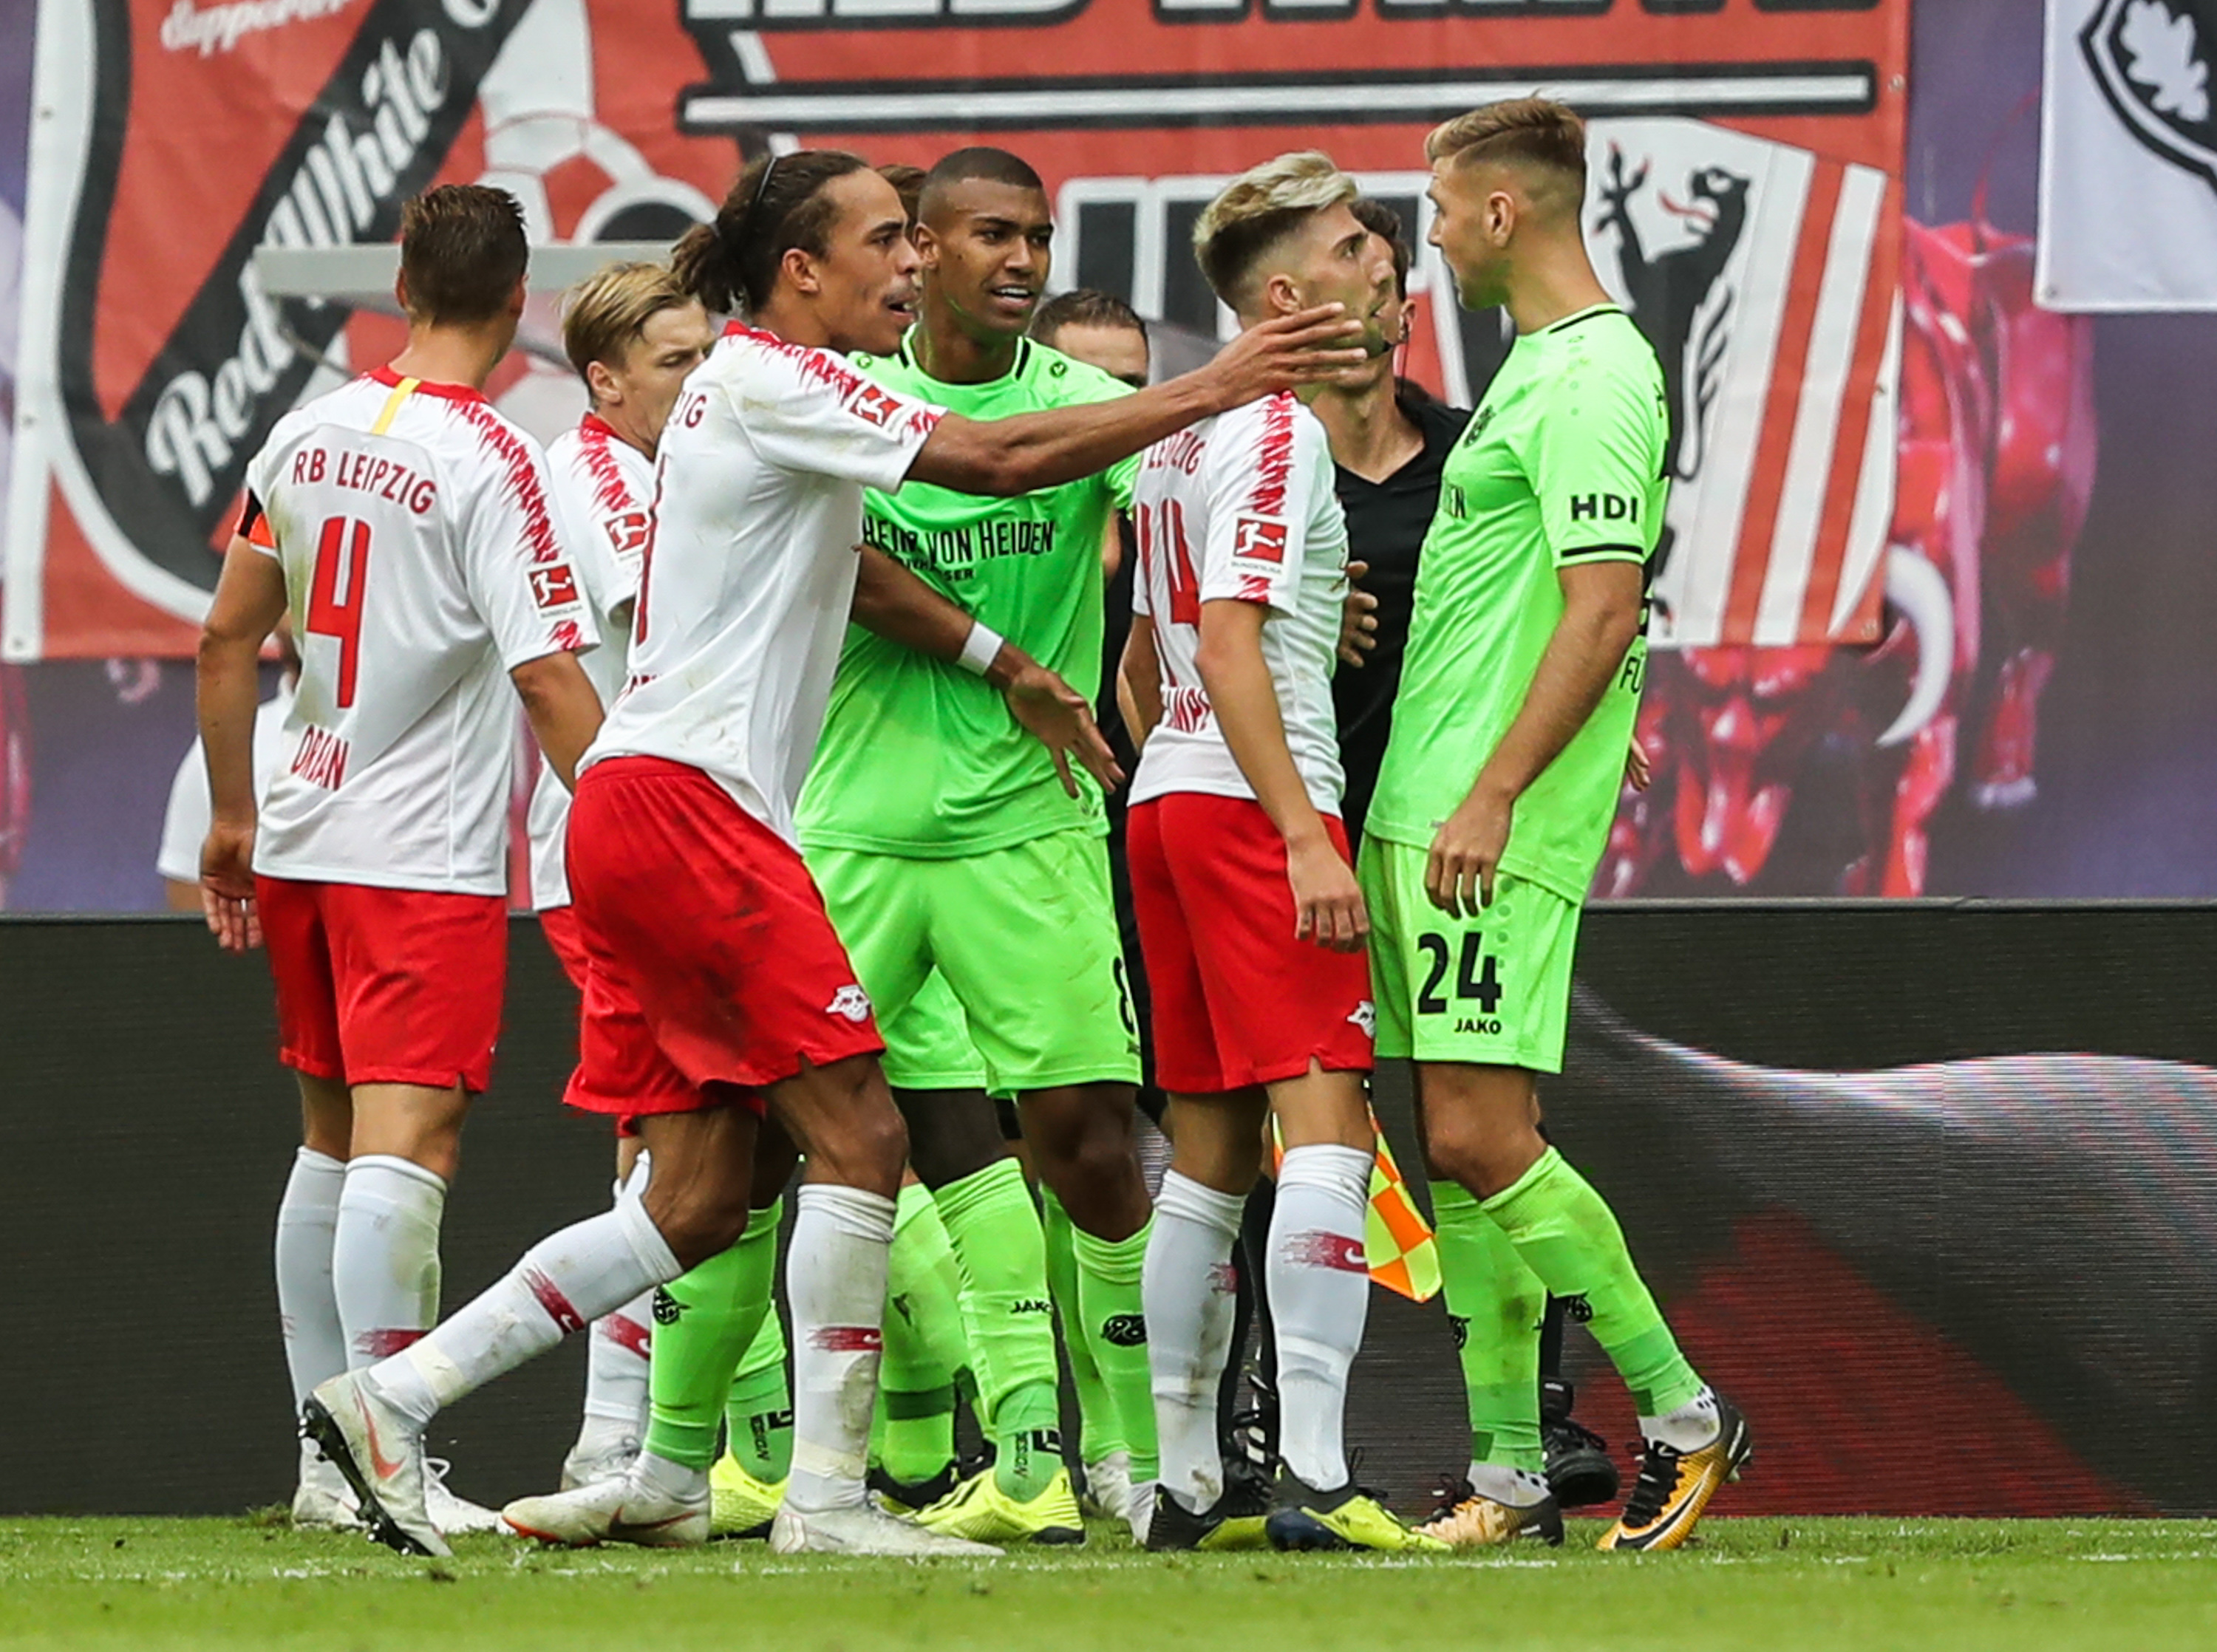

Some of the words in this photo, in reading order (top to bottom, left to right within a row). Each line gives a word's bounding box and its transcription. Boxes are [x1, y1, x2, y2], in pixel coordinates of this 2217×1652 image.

[293, 448, 327, 485] RB
[336, 451, 436, 515] LEIPZIG
[1570, 493, 1638, 524] HDI
[925, 528, 973, 563] VON
[978, 519, 1054, 559] HEIDEN
[305, 516, 372, 709] 4
[1418, 932, 1502, 1014] 24
[1454, 1019, 1502, 1034] JAKO
